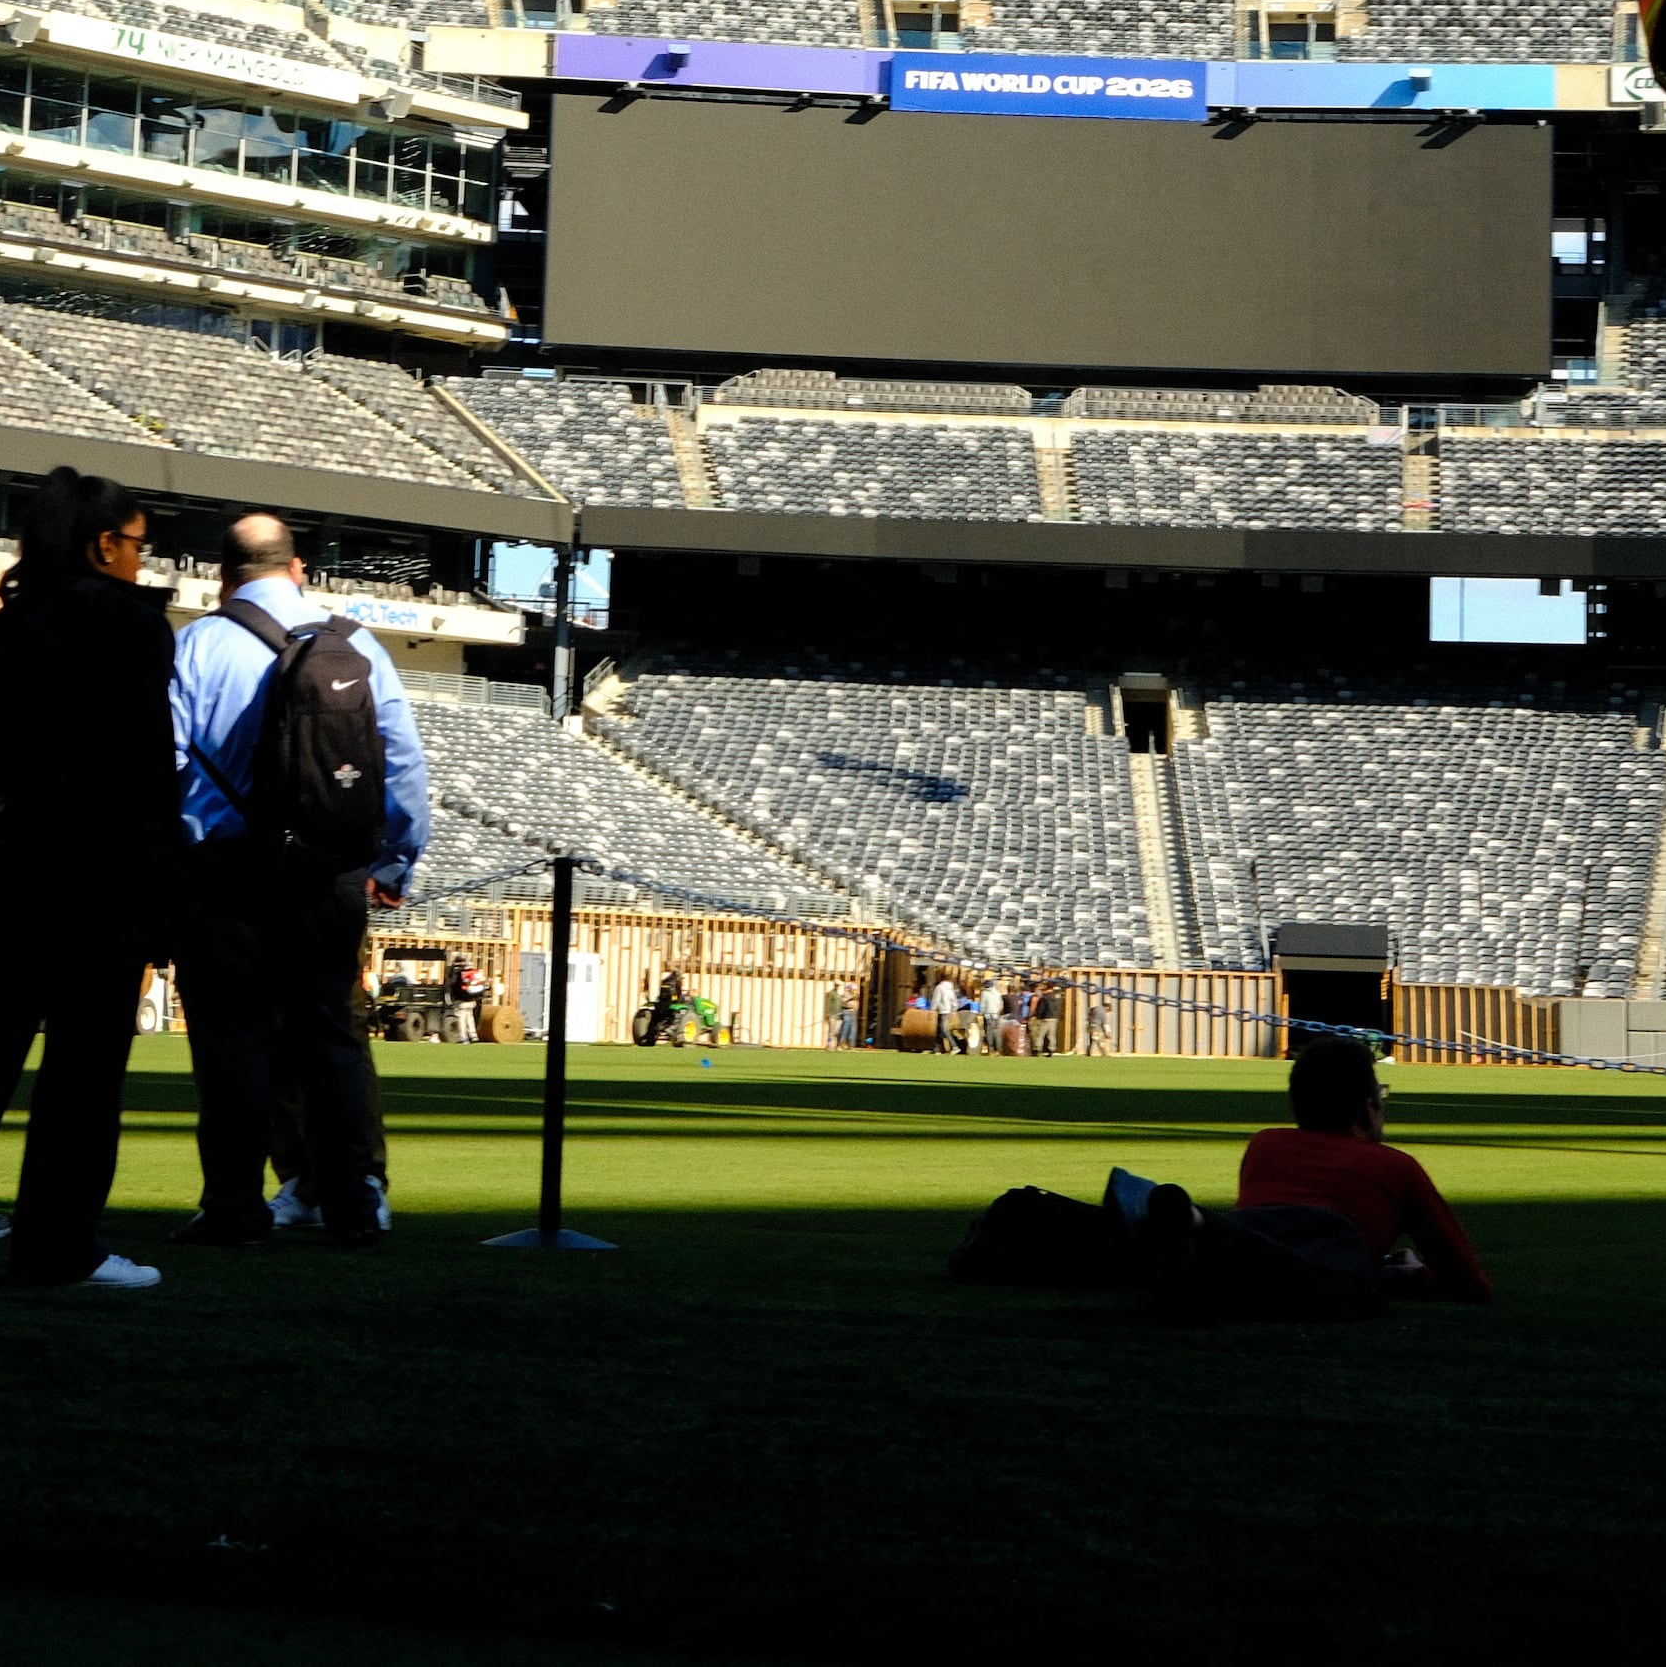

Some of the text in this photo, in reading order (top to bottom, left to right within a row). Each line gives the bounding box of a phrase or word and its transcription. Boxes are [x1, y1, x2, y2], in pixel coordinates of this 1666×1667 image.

[112, 27, 146, 55] 74
[904, 70, 1194, 99] FIFA WORLD CUP 2026
